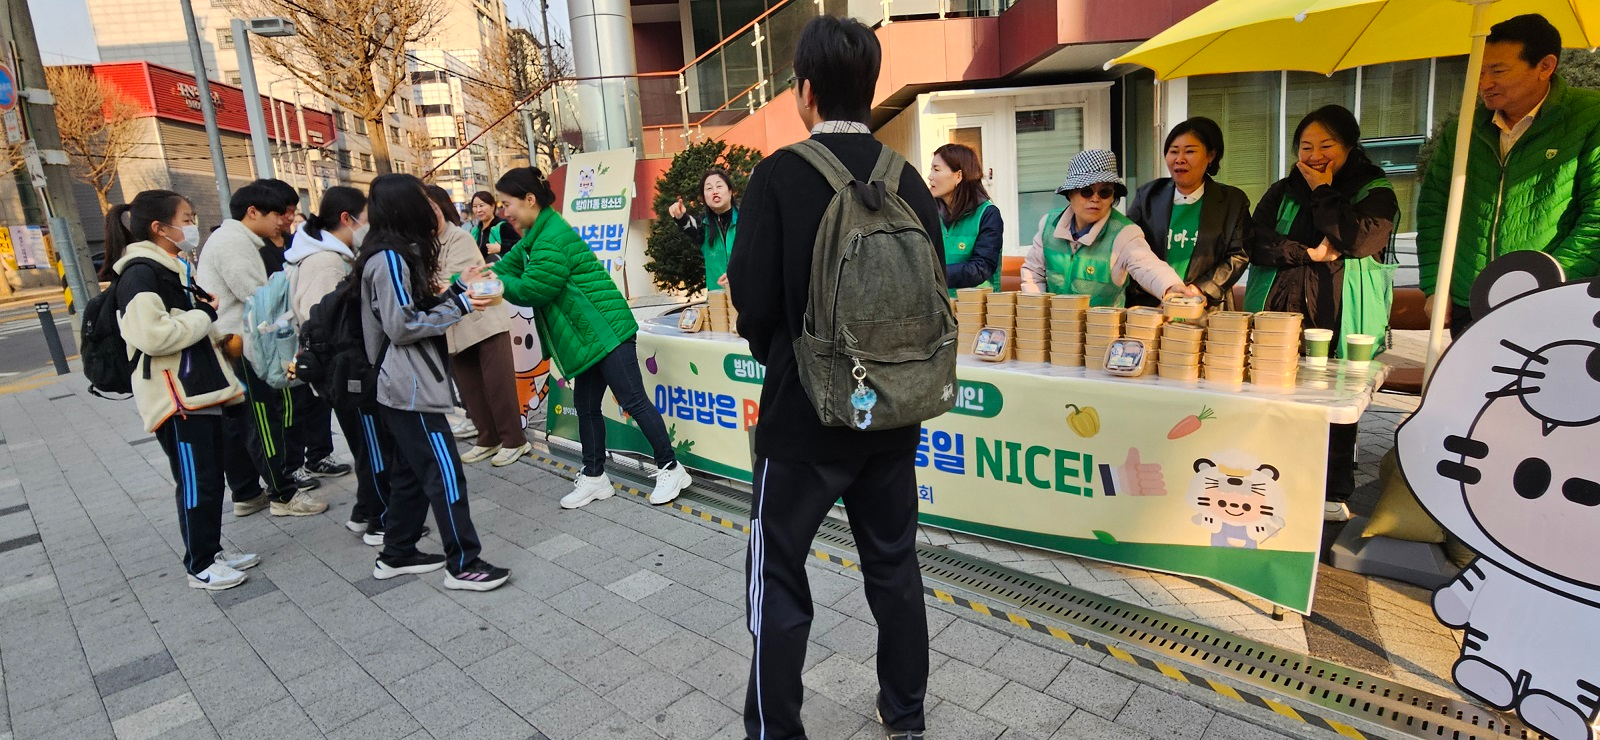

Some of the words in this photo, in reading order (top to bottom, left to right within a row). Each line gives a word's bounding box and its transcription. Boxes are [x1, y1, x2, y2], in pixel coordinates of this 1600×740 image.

[576, 199, 600, 211] 방이1동
[601, 197, 622, 209] 청소년
[734, 358, 767, 380] 방이1
[655, 384, 737, 429] 아침밥은
[974, 436, 1094, 498] NICE!
[917, 484, 934, 504] 회
